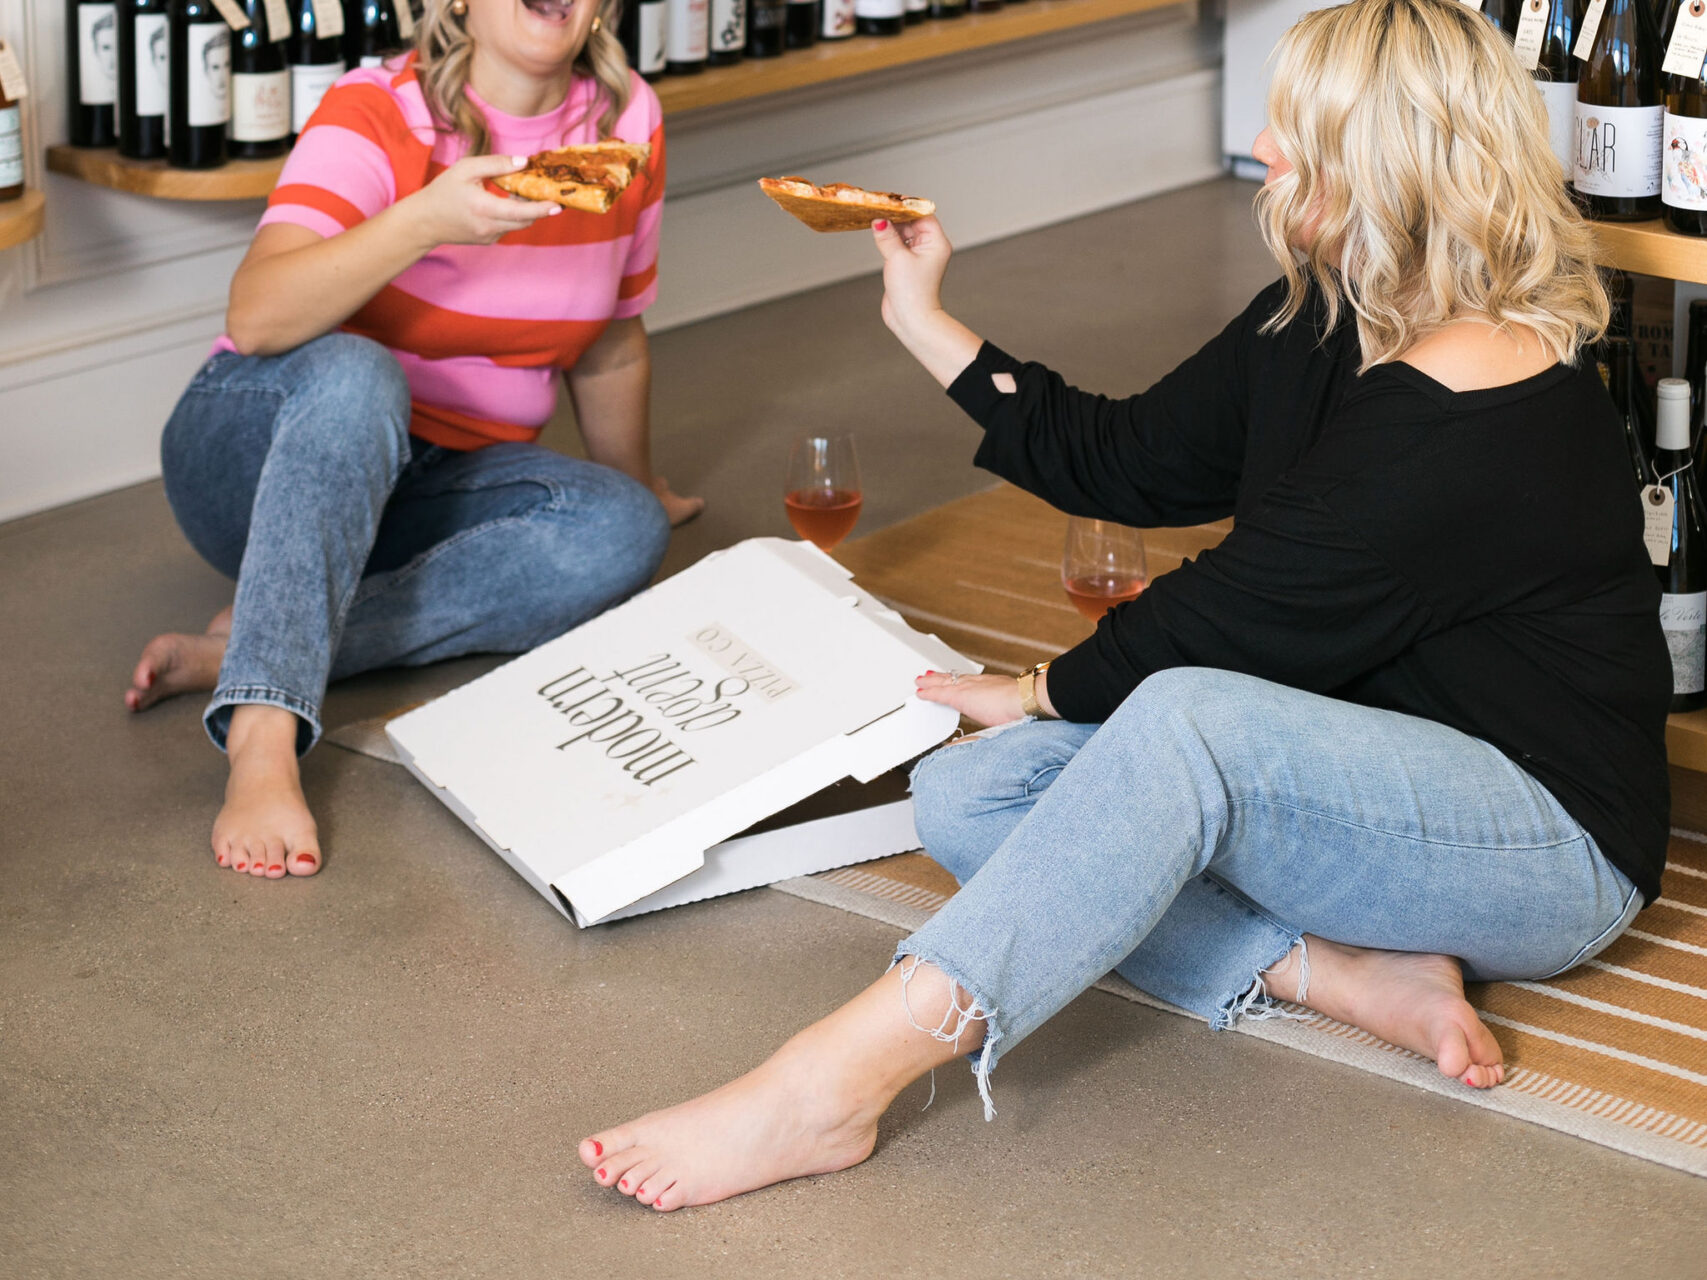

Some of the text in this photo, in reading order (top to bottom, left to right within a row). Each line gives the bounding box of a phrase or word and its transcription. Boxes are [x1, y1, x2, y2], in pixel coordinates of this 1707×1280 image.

[600, 652, 750, 732] agent
[695, 628, 793, 700] PIZZA CO
[536, 665, 699, 787] modern
